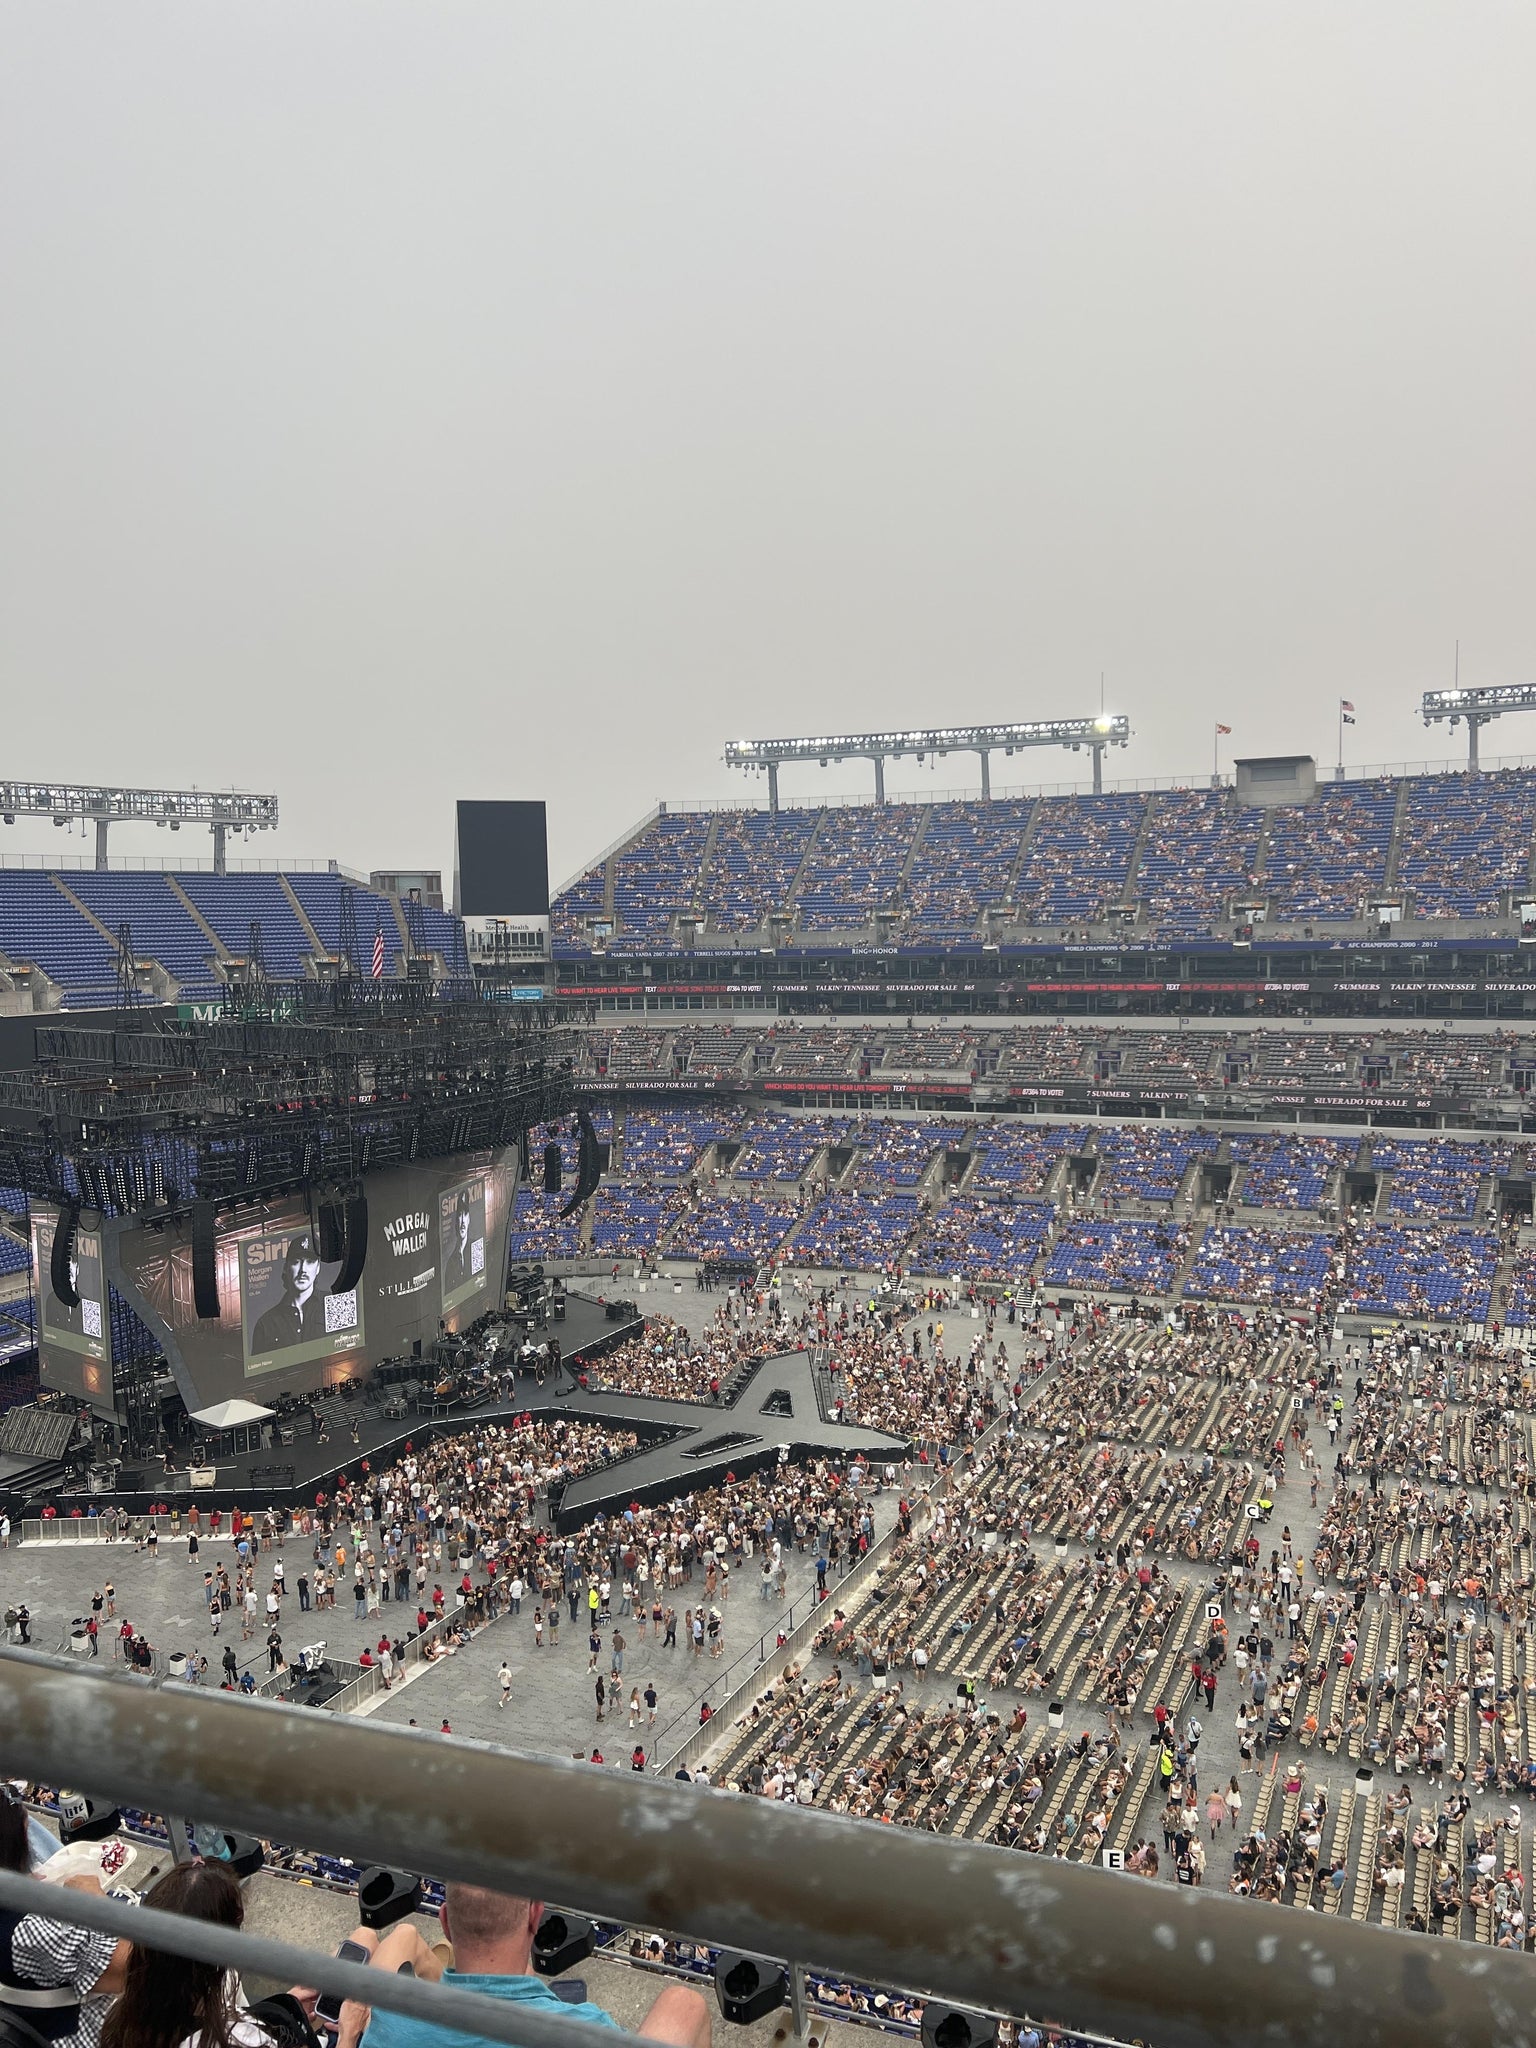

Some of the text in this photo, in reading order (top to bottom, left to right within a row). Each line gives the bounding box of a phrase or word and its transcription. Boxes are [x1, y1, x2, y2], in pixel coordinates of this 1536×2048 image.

[1314, 1097, 1364, 1105] SILVERADO
[384, 1212, 430, 1242] MORGAN
[392, 1232, 427, 1256] WALLEN
[247, 1238, 291, 1264] Siri
[248, 1266, 272, 1276] Morgan
[248, 1274, 270, 1282] Wallen
[378, 1280, 413, 1296] STILL
[1294, 1398, 1300, 1408] B
[1248, 1506, 1256, 1516] C
[1208, 1606, 1220, 1617] D
[64, 1803, 84, 1818] Lite
[1110, 1853, 1120, 1868] E
